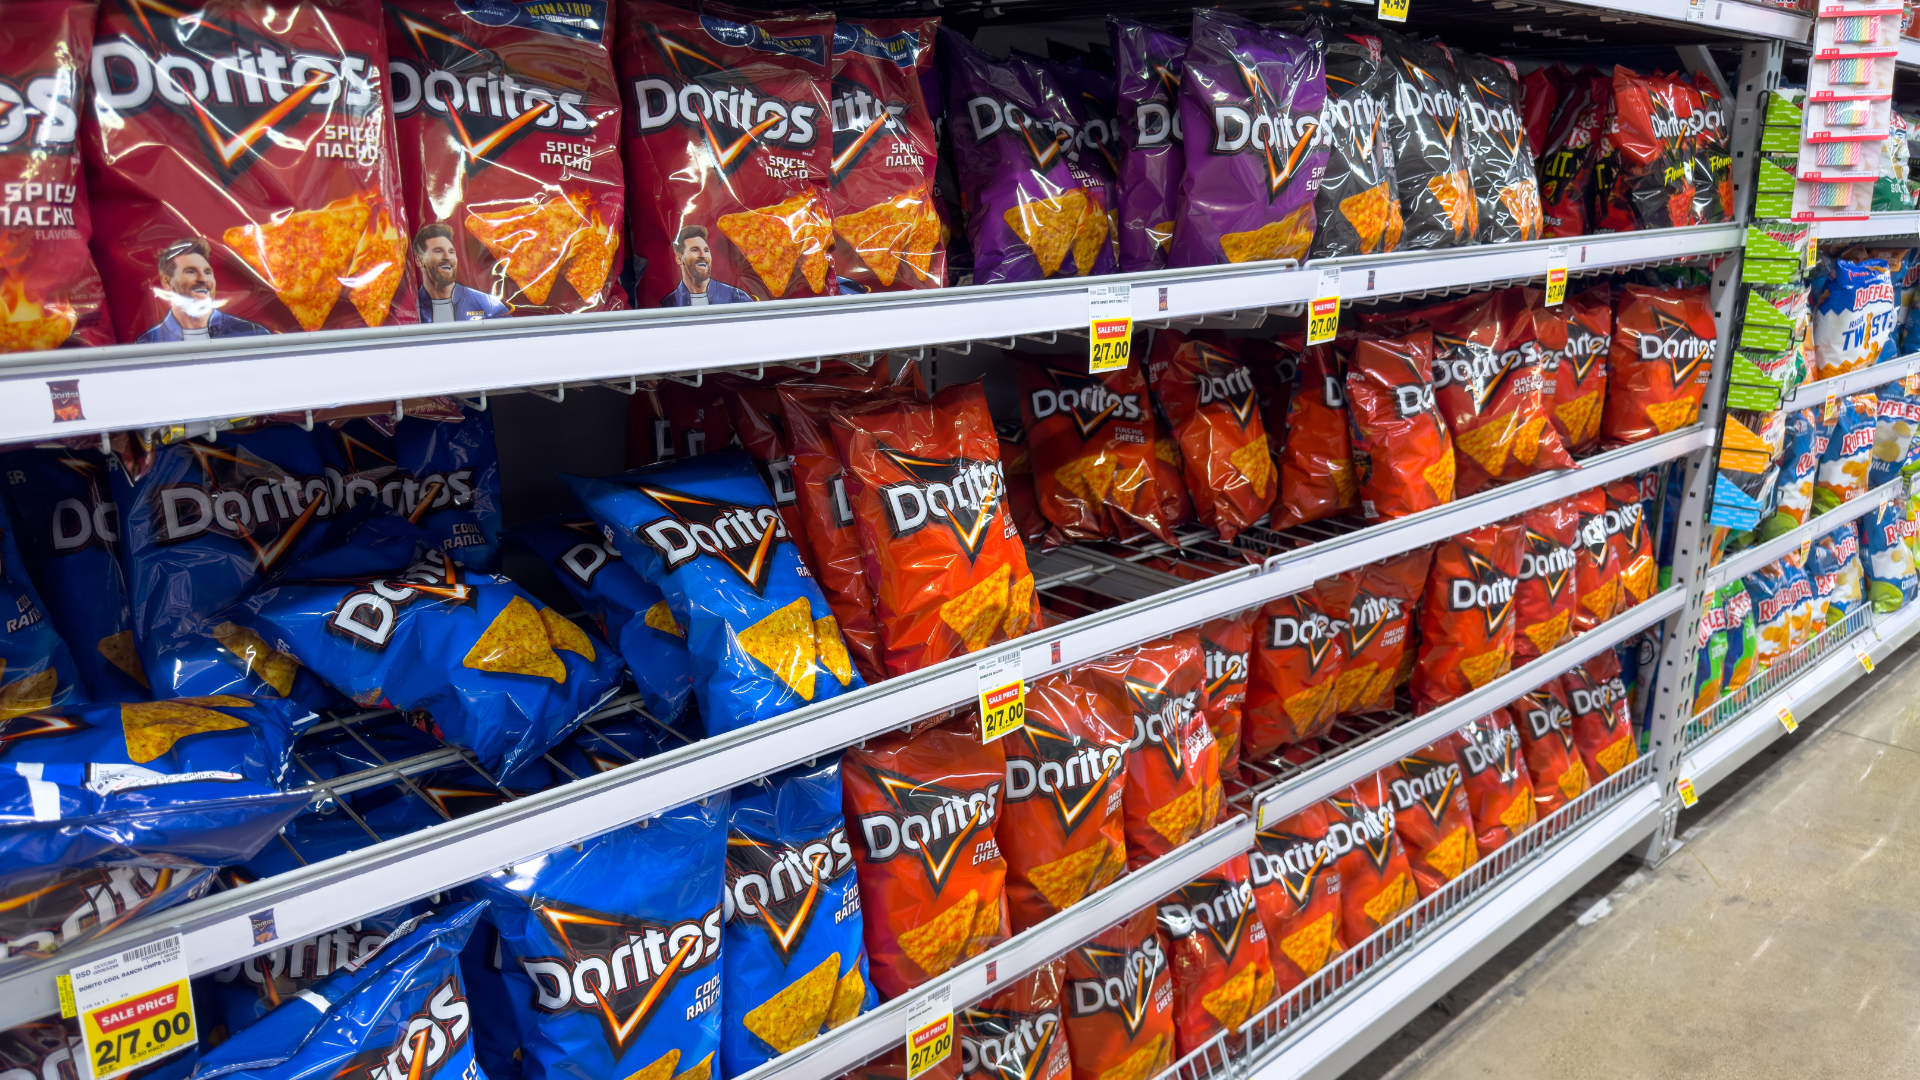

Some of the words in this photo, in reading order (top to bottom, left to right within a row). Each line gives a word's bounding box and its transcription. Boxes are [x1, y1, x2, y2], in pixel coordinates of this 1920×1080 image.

[526, 3, 557, 16] WIN
[557, 3, 566, 13] A
[566, 3, 592, 17] TRIP
[790, 38, 812, 49] TRIP
[92, 41, 373, 108] Doritos
[390, 63, 587, 130] Doritos
[635, 79, 815, 144] Doritos
[325, 125, 376, 143] SPICY
[1215, 107, 1332, 151] Doritos
[1650, 114, 1697, 138] Doritos
[316, 143, 379, 159] NACHO
[546, 141, 591, 157] SPICY
[540, 153, 592, 172] NACHO
[769, 154, 806, 168] SPICY
[886, 155, 924, 167] NACHO
[5, 183, 76, 203] SPICY
[1855, 284, 1894, 308] RUFFLES
[1314, 303, 1324, 311] SALE
[1324, 302, 1336, 310] PRICE
[1097, 325, 1110, 334] SALE
[1112, 325, 1126, 333] PRICE
[1310, 316, 1337, 336] 2/7.00
[1093, 341, 1128, 363] 2/7.00
[1641, 335, 1717, 359] Doritos
[1432, 340, 1540, 388] Doritos
[51, 391, 79, 400] Doritos
[1031, 385, 1141, 418] Doritos
[1115, 427, 1143, 436] NACHO
[1115, 433, 1146, 444] CHEESE
[453, 523, 479, 534] COOL
[444, 534, 486, 550] RANCH
[1384, 626, 1405, 639] NACHO
[988, 694, 1002, 705] SALE
[1002, 688, 1018, 700] PRICE
[986, 702, 1023, 732] 2/7.00
[863, 782, 998, 859] Doritos
[524, 906, 722, 1009] Doritos
[75, 969, 92, 980] DSD
[79, 980, 103, 993] DORITO
[103, 974, 120, 984] COOL
[121, 967, 142, 978] RANCH
[144, 960, 162, 970] CHIPS
[695, 972, 721, 1000] COOL
[101, 1007, 134, 1027] SALE
[137, 993, 175, 1014] PRICE
[686, 984, 721, 1020] RANCH
[95, 1011, 191, 1067] 2/7.00
[915, 1033, 930, 1044] SALE
[930, 1021, 947, 1036] PRICE
[131, 1050, 147, 1060] 3.50
[148, 1043, 165, 1053] each
[911, 1034, 950, 1070] 2/7.00
